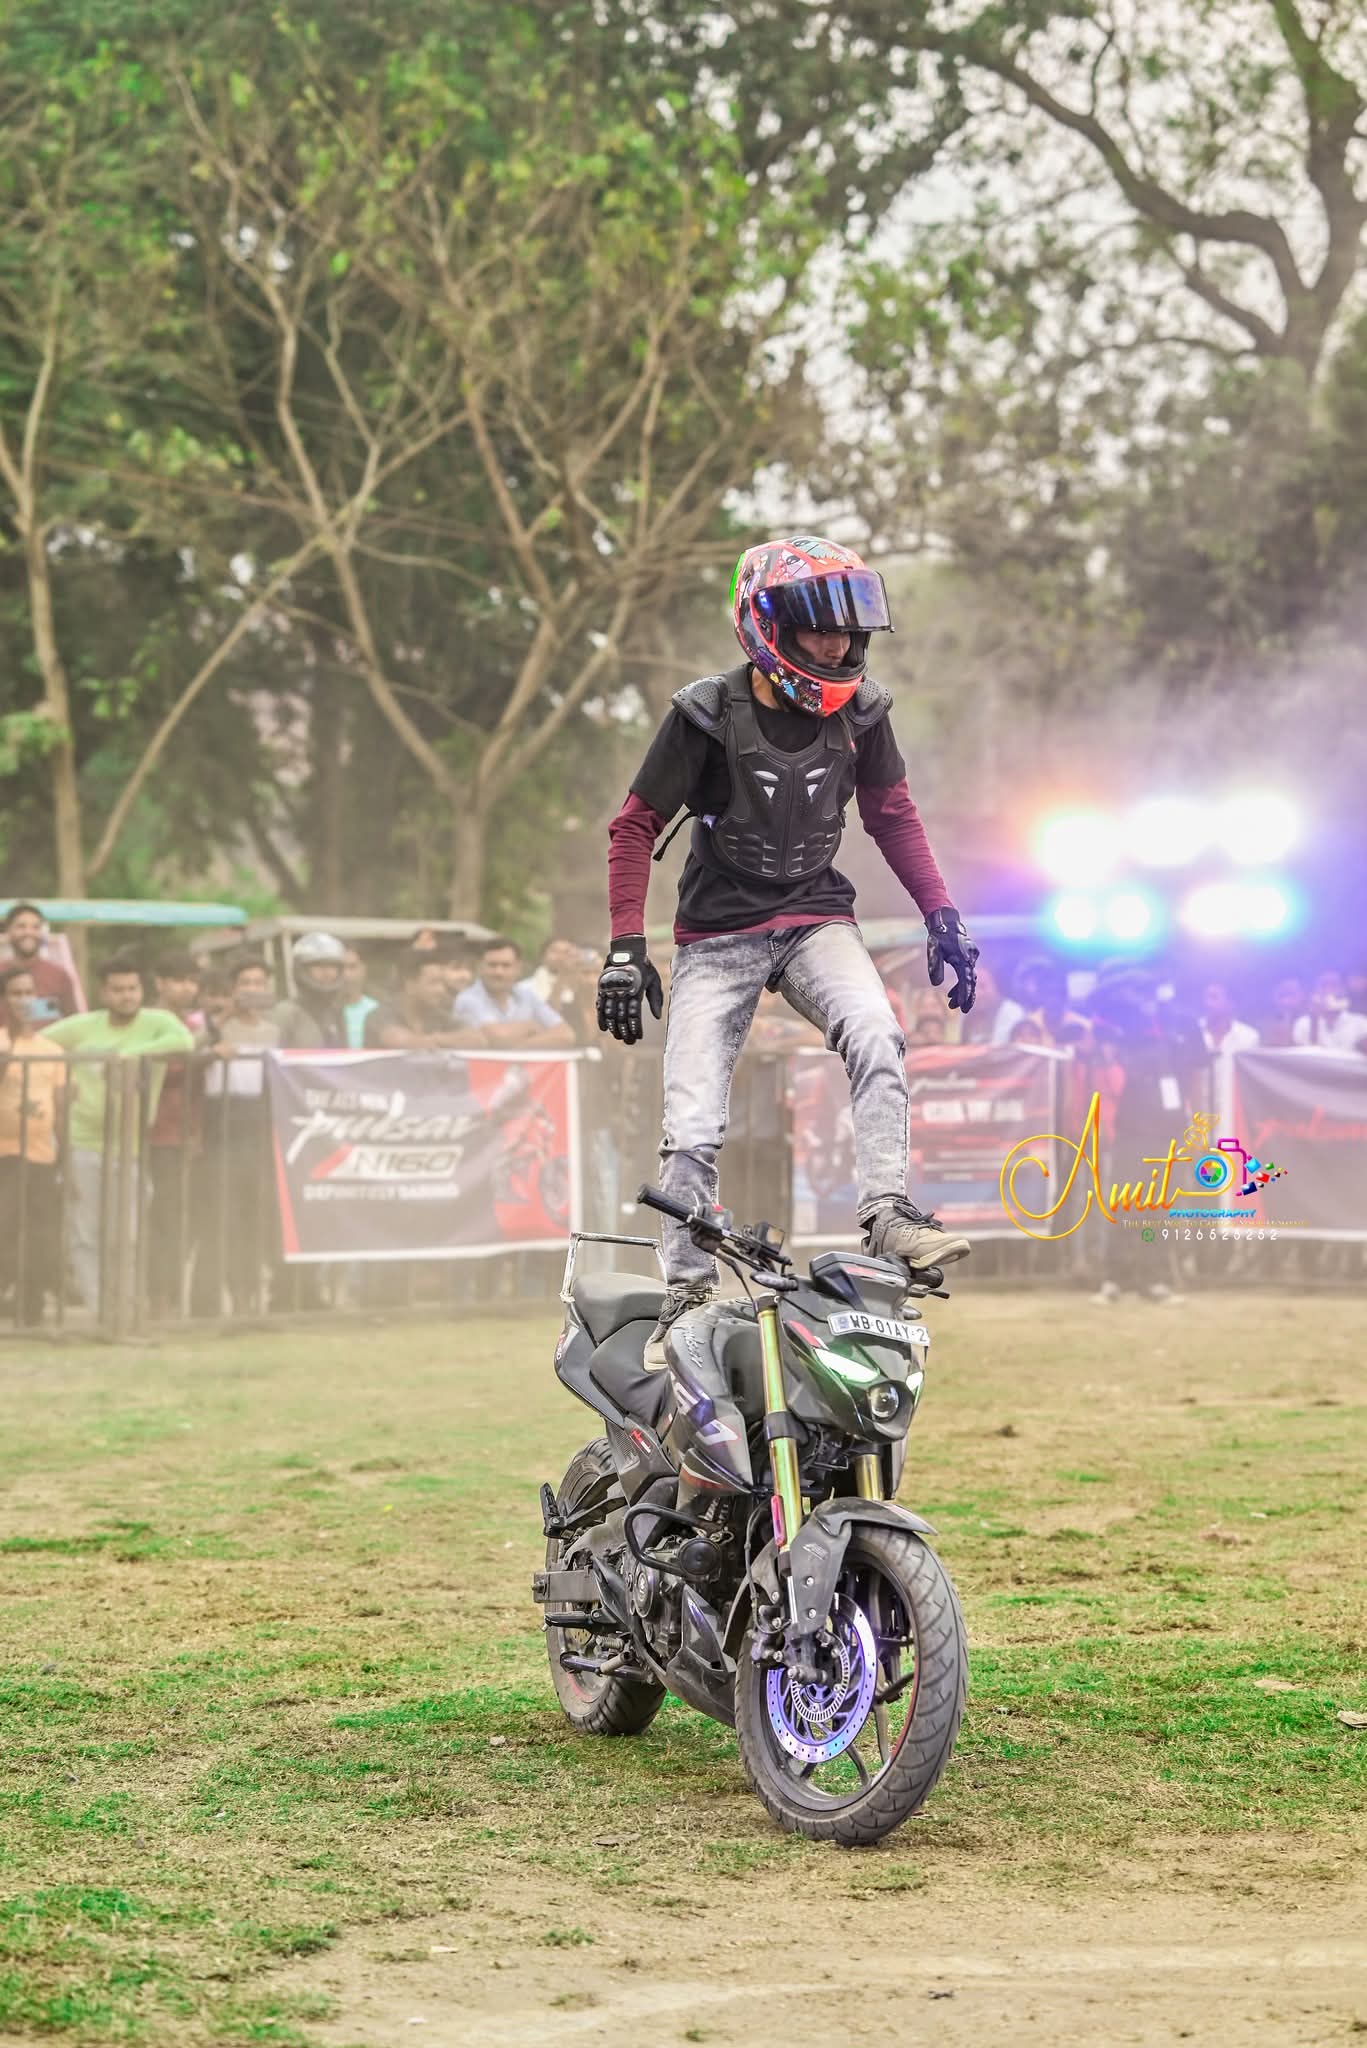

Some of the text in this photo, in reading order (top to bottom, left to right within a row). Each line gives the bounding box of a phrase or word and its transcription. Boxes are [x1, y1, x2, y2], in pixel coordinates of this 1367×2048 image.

[354, 1151, 457, 1173] N160
[850, 1314, 929, 1342] WB 01AY 2
